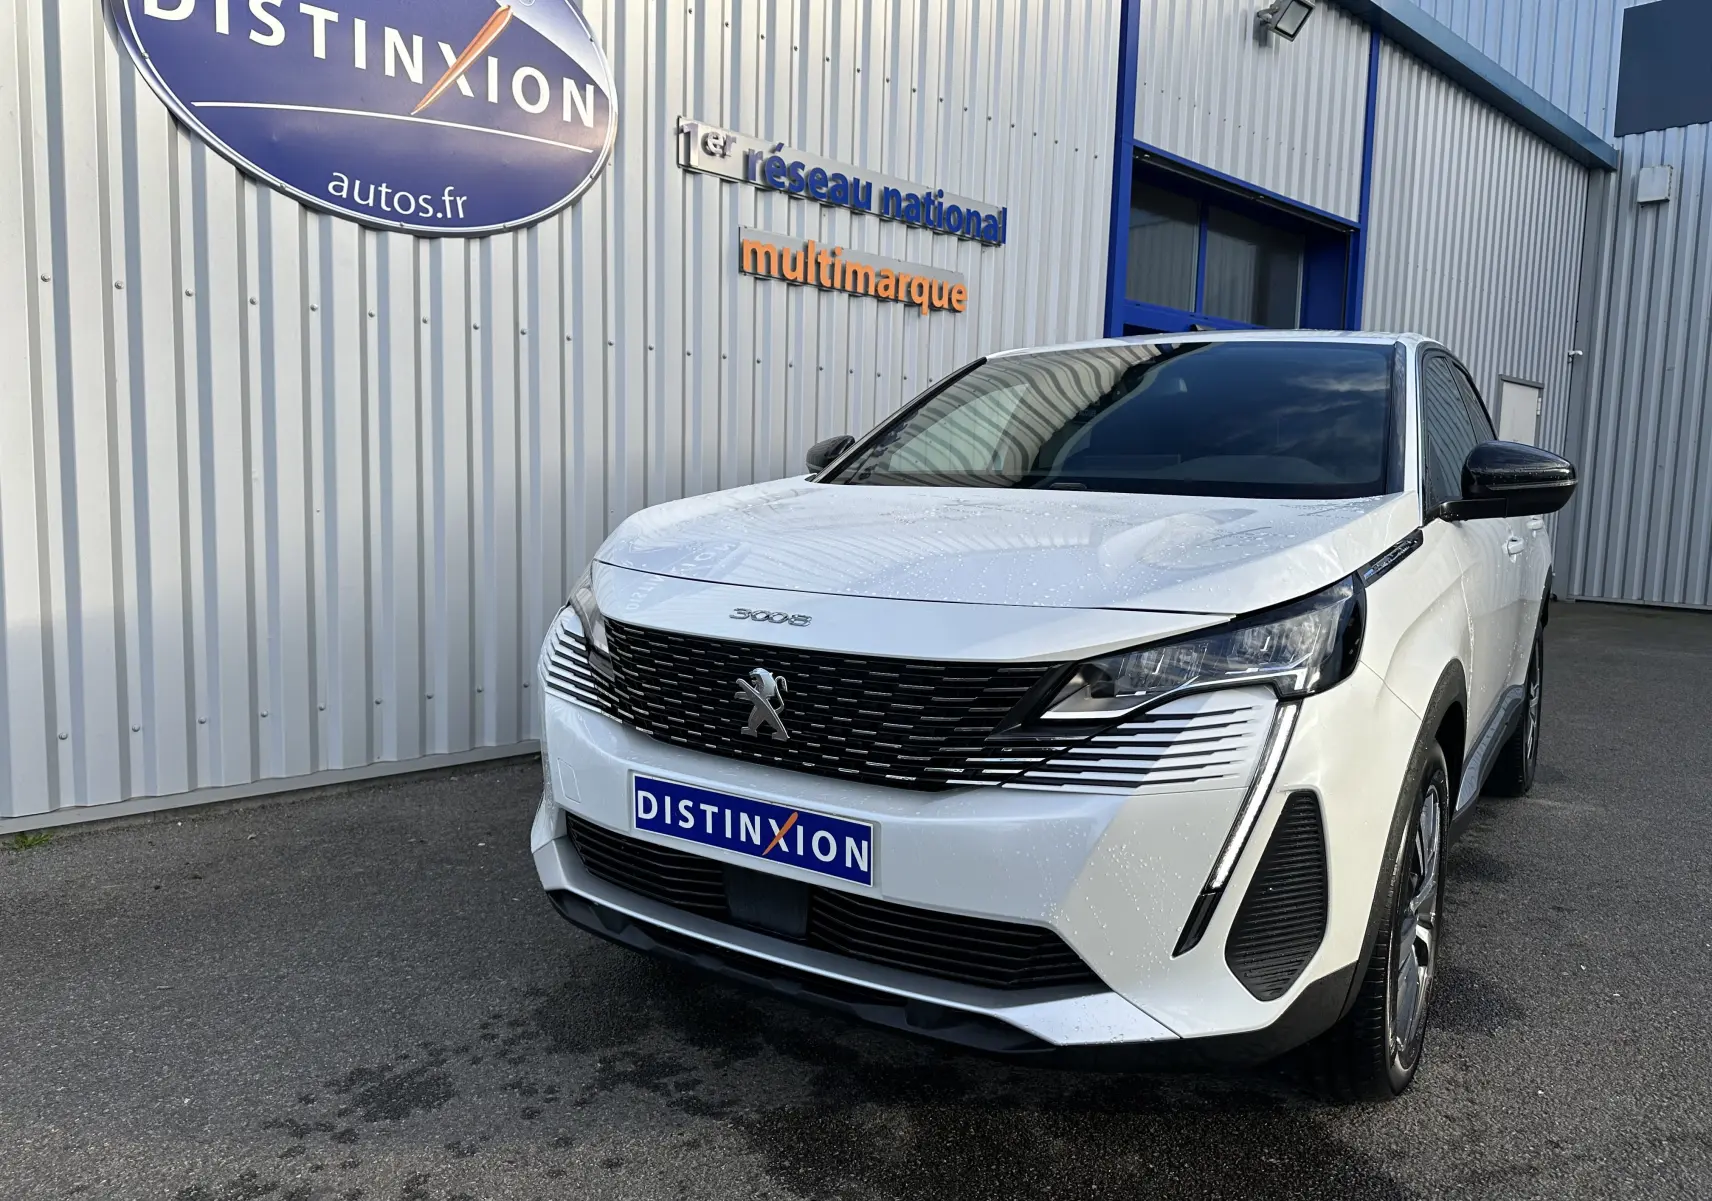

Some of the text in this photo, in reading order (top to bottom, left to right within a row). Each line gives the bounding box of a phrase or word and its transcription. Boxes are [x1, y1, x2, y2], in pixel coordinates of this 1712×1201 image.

[327, 171, 467, 219] autos.fr
[679, 122, 1007, 244] 1er réseau national
[742, 238, 968, 315] multimarque
[728, 607, 813, 627] 3008
[637, 789, 868, 872] DISTINXION
